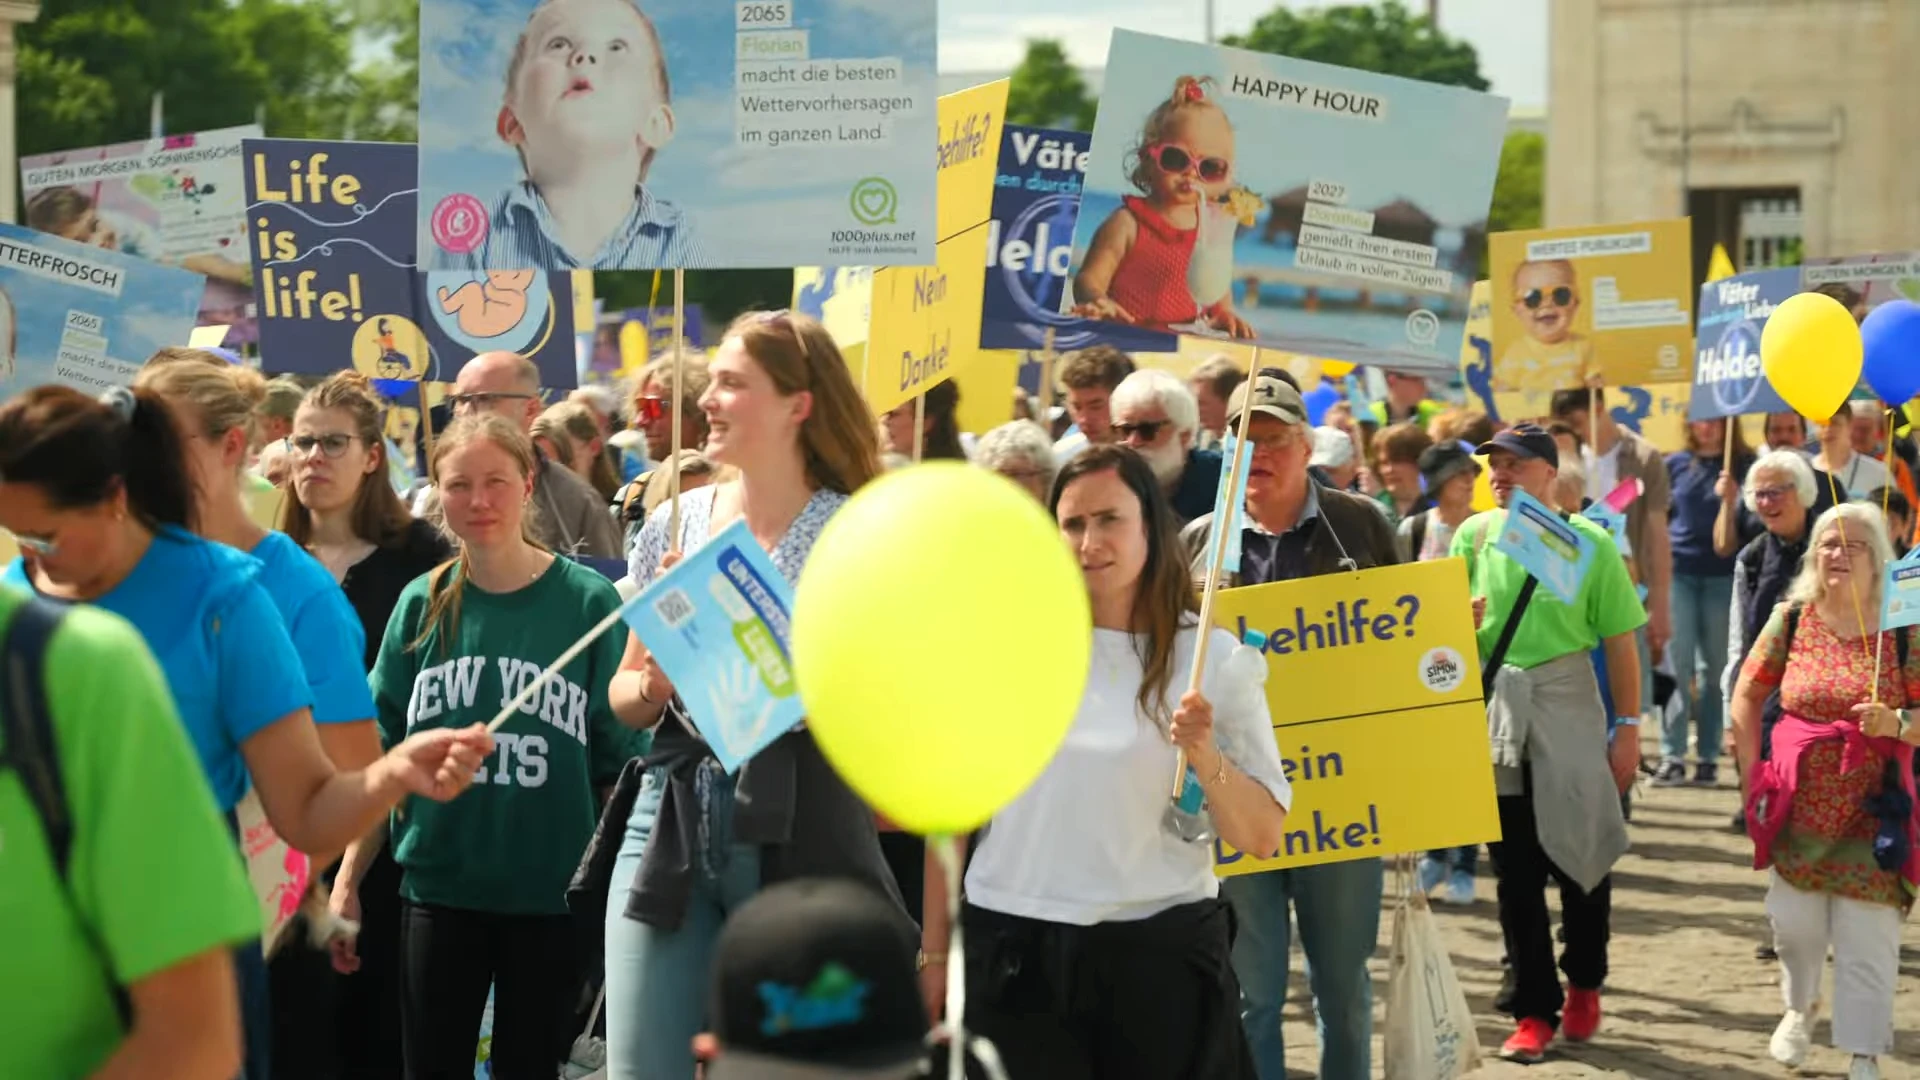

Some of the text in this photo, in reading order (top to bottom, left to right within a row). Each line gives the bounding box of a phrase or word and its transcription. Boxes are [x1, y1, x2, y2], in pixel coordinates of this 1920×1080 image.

[742, 5, 786, 22] 2065
[742, 37, 804, 53] Florian
[742, 64, 896, 83] macht die besten
[741, 94, 913, 115] Wettervorhersagen
[1232, 74, 1380, 117] HAPPY HOUR
[741, 129, 762, 143] im
[768, 129, 832, 148] ganzen
[1012, 132, 1089, 173] Väte
[27, 166, 76, 186] GUTEN
[254, 153, 361, 205] Life
[1313, 182, 1345, 199] 2027
[257, 217, 297, 261] is
[831, 230, 916, 244] 1000plus.net
[1303, 231, 1432, 262] genießt ihren ersten
[1299, 251, 1342, 269] Urlaub
[1346, 259, 1357, 272] in
[1361, 261, 1399, 281] vollen
[262, 268, 363, 322] life!
[913, 268, 947, 312] Nein
[70, 313, 98, 328] 2065
[61, 350, 95, 367] macht
[900, 327, 951, 391] Danke!
[1697, 339, 1765, 385] Helde
[498, 656, 588, 747] YORK
[1283, 745, 1344, 783] ein
[1214, 804, 1382, 865] Dnke!
